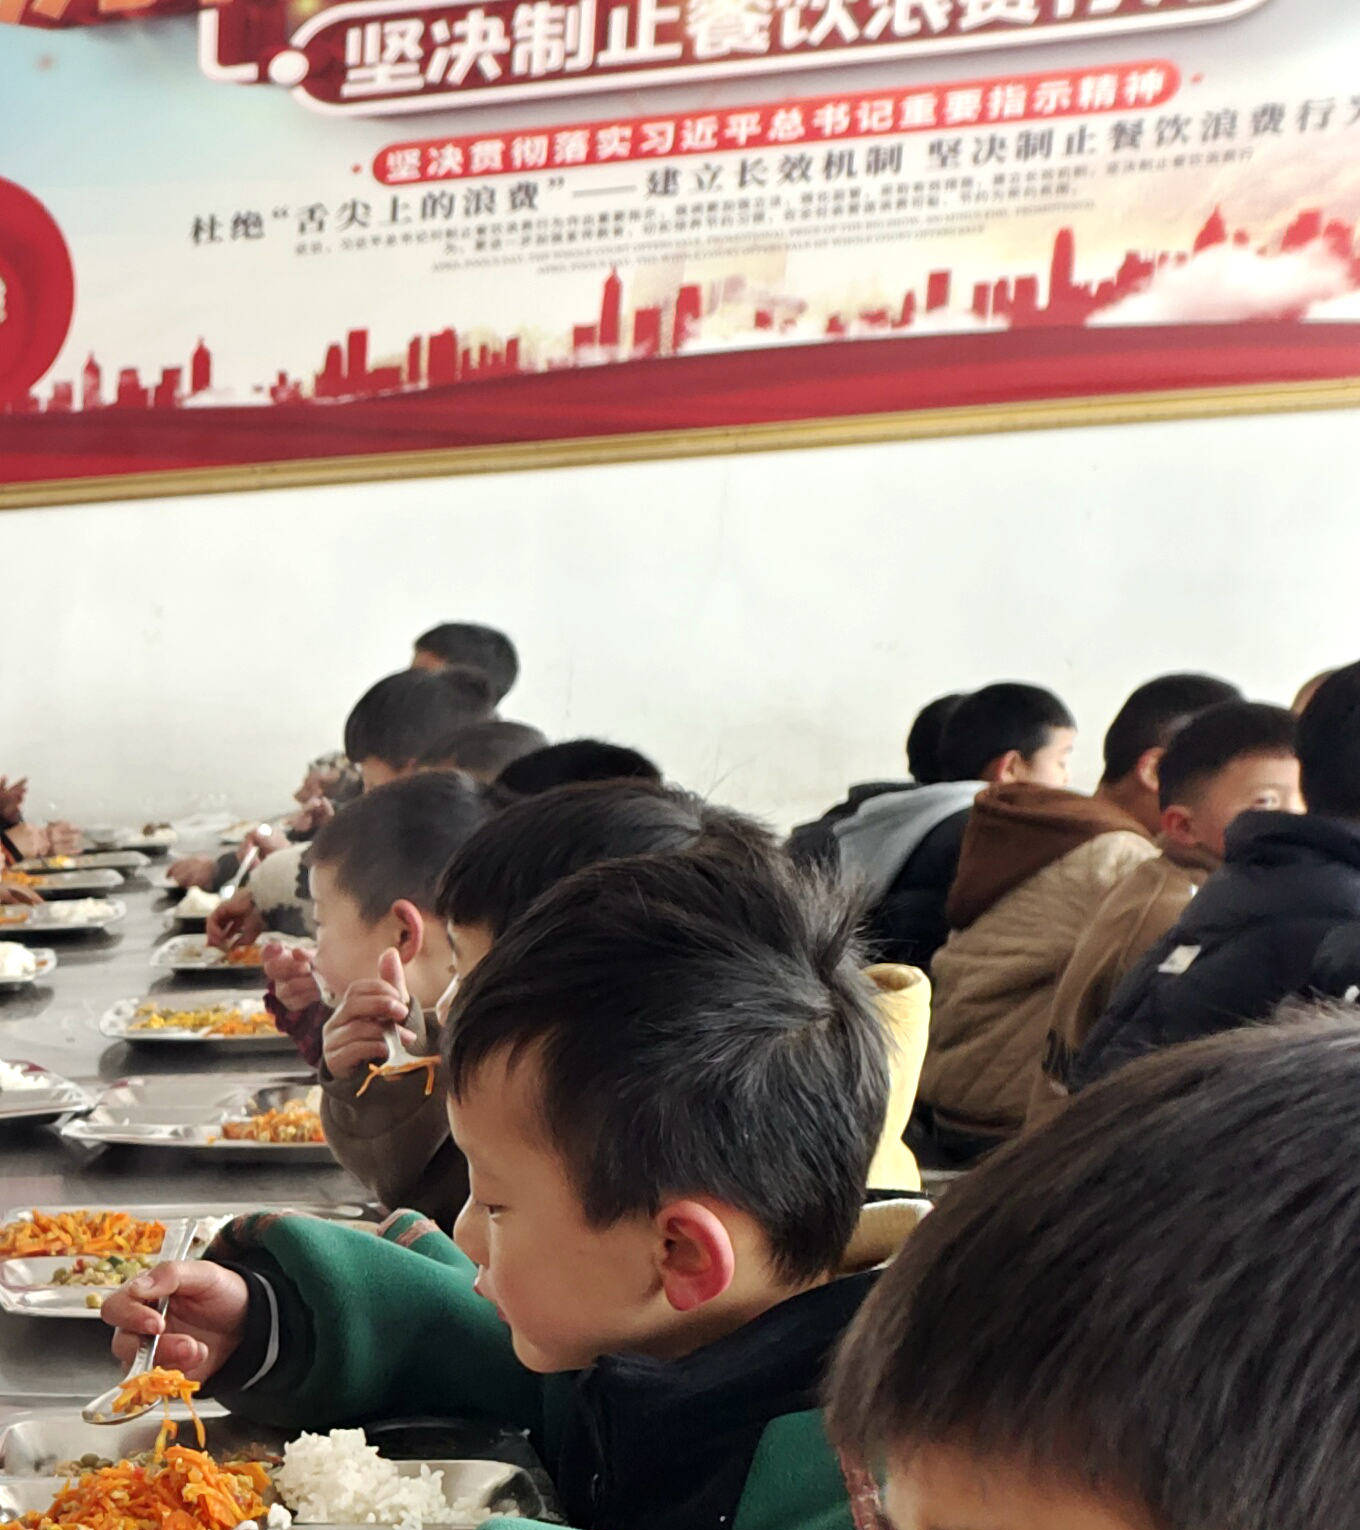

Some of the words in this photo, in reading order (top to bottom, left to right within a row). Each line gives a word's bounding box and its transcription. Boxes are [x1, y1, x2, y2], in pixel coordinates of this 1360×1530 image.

[385, 70, 1167, 182] 坚决贯彻落实习近平总书记重要指示精神
